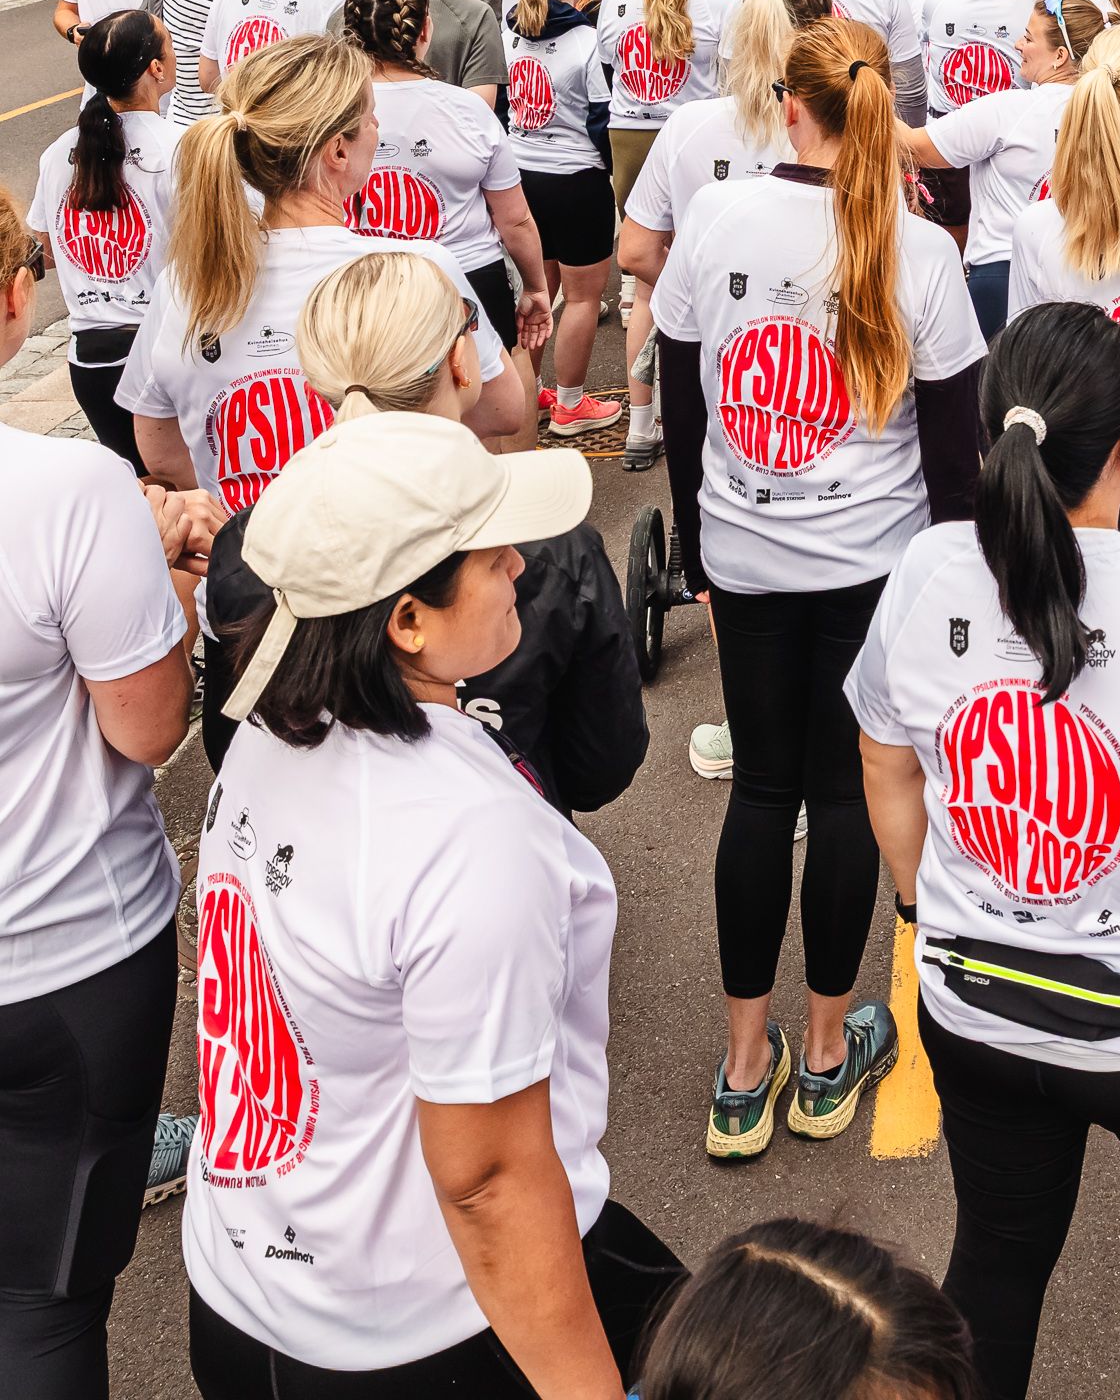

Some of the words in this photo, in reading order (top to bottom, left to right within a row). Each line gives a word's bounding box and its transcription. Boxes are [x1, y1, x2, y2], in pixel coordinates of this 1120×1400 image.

[944, 45, 1012, 94] YPSILON
[509, 60, 552, 111] YPSILON
[620, 70, 647, 101] RUN
[648, 71, 682, 102] 2026
[66, 236, 106, 276] RUN
[823, 300, 840, 308] TORS
[826, 308, 839, 316] SPO
[732, 326, 743, 336] 2026
[746, 315, 769, 328] YPSILON
[795, 317, 808, 328] CLUB
[808, 324, 821, 335] 2026
[230, 374, 253, 389] YPSILON
[254, 368, 282, 380] RUNNING
[720, 324, 850, 430] YPSILON
[720, 404, 772, 467] RUN
[774, 414, 840, 470] 2026
[755, 467, 769, 476] CLUB
[768, 470, 794, 478] RUNNING
[794, 464, 816, 478] YPSILON
[818, 492, 852, 502] Domino's
[1084, 650, 1116, 659] RSHOV
[972, 680, 998, 695] YPSILON
[1000, 678, 1031, 688] RUNNING
[943, 706, 955, 724] CLUB
[954, 694, 968, 709] 2026
[1079, 703, 1106, 730] YPSILON
[947, 805, 1019, 893] RUN
[1026, 818, 1112, 896] 2026
[266, 860, 293, 888] TORSHOV
[964, 854, 991, 878] YPSILON
[1103, 859, 1118, 876] CLUB
[208, 872, 225, 886] YPSILON
[225, 872, 242, 892] RUNNING
[264, 875, 282, 898] SPORT
[991, 875, 1004, 892] 2026
[1087, 871, 1105, 888] 2026
[1004, 888, 1020, 903] CLUB
[1022, 896, 1053, 907] RUNNING
[1054, 892, 1082, 906] YPSILON
[272, 973, 292, 1019] RUNNING
[288, 1020, 304, 1046] CLUB
[300, 1043, 316, 1066] 2026
[308, 1078, 321, 1116] YPSILON
[298, 1116, 317, 1152] RUNNING
[276, 1158, 297, 1179] 2026
